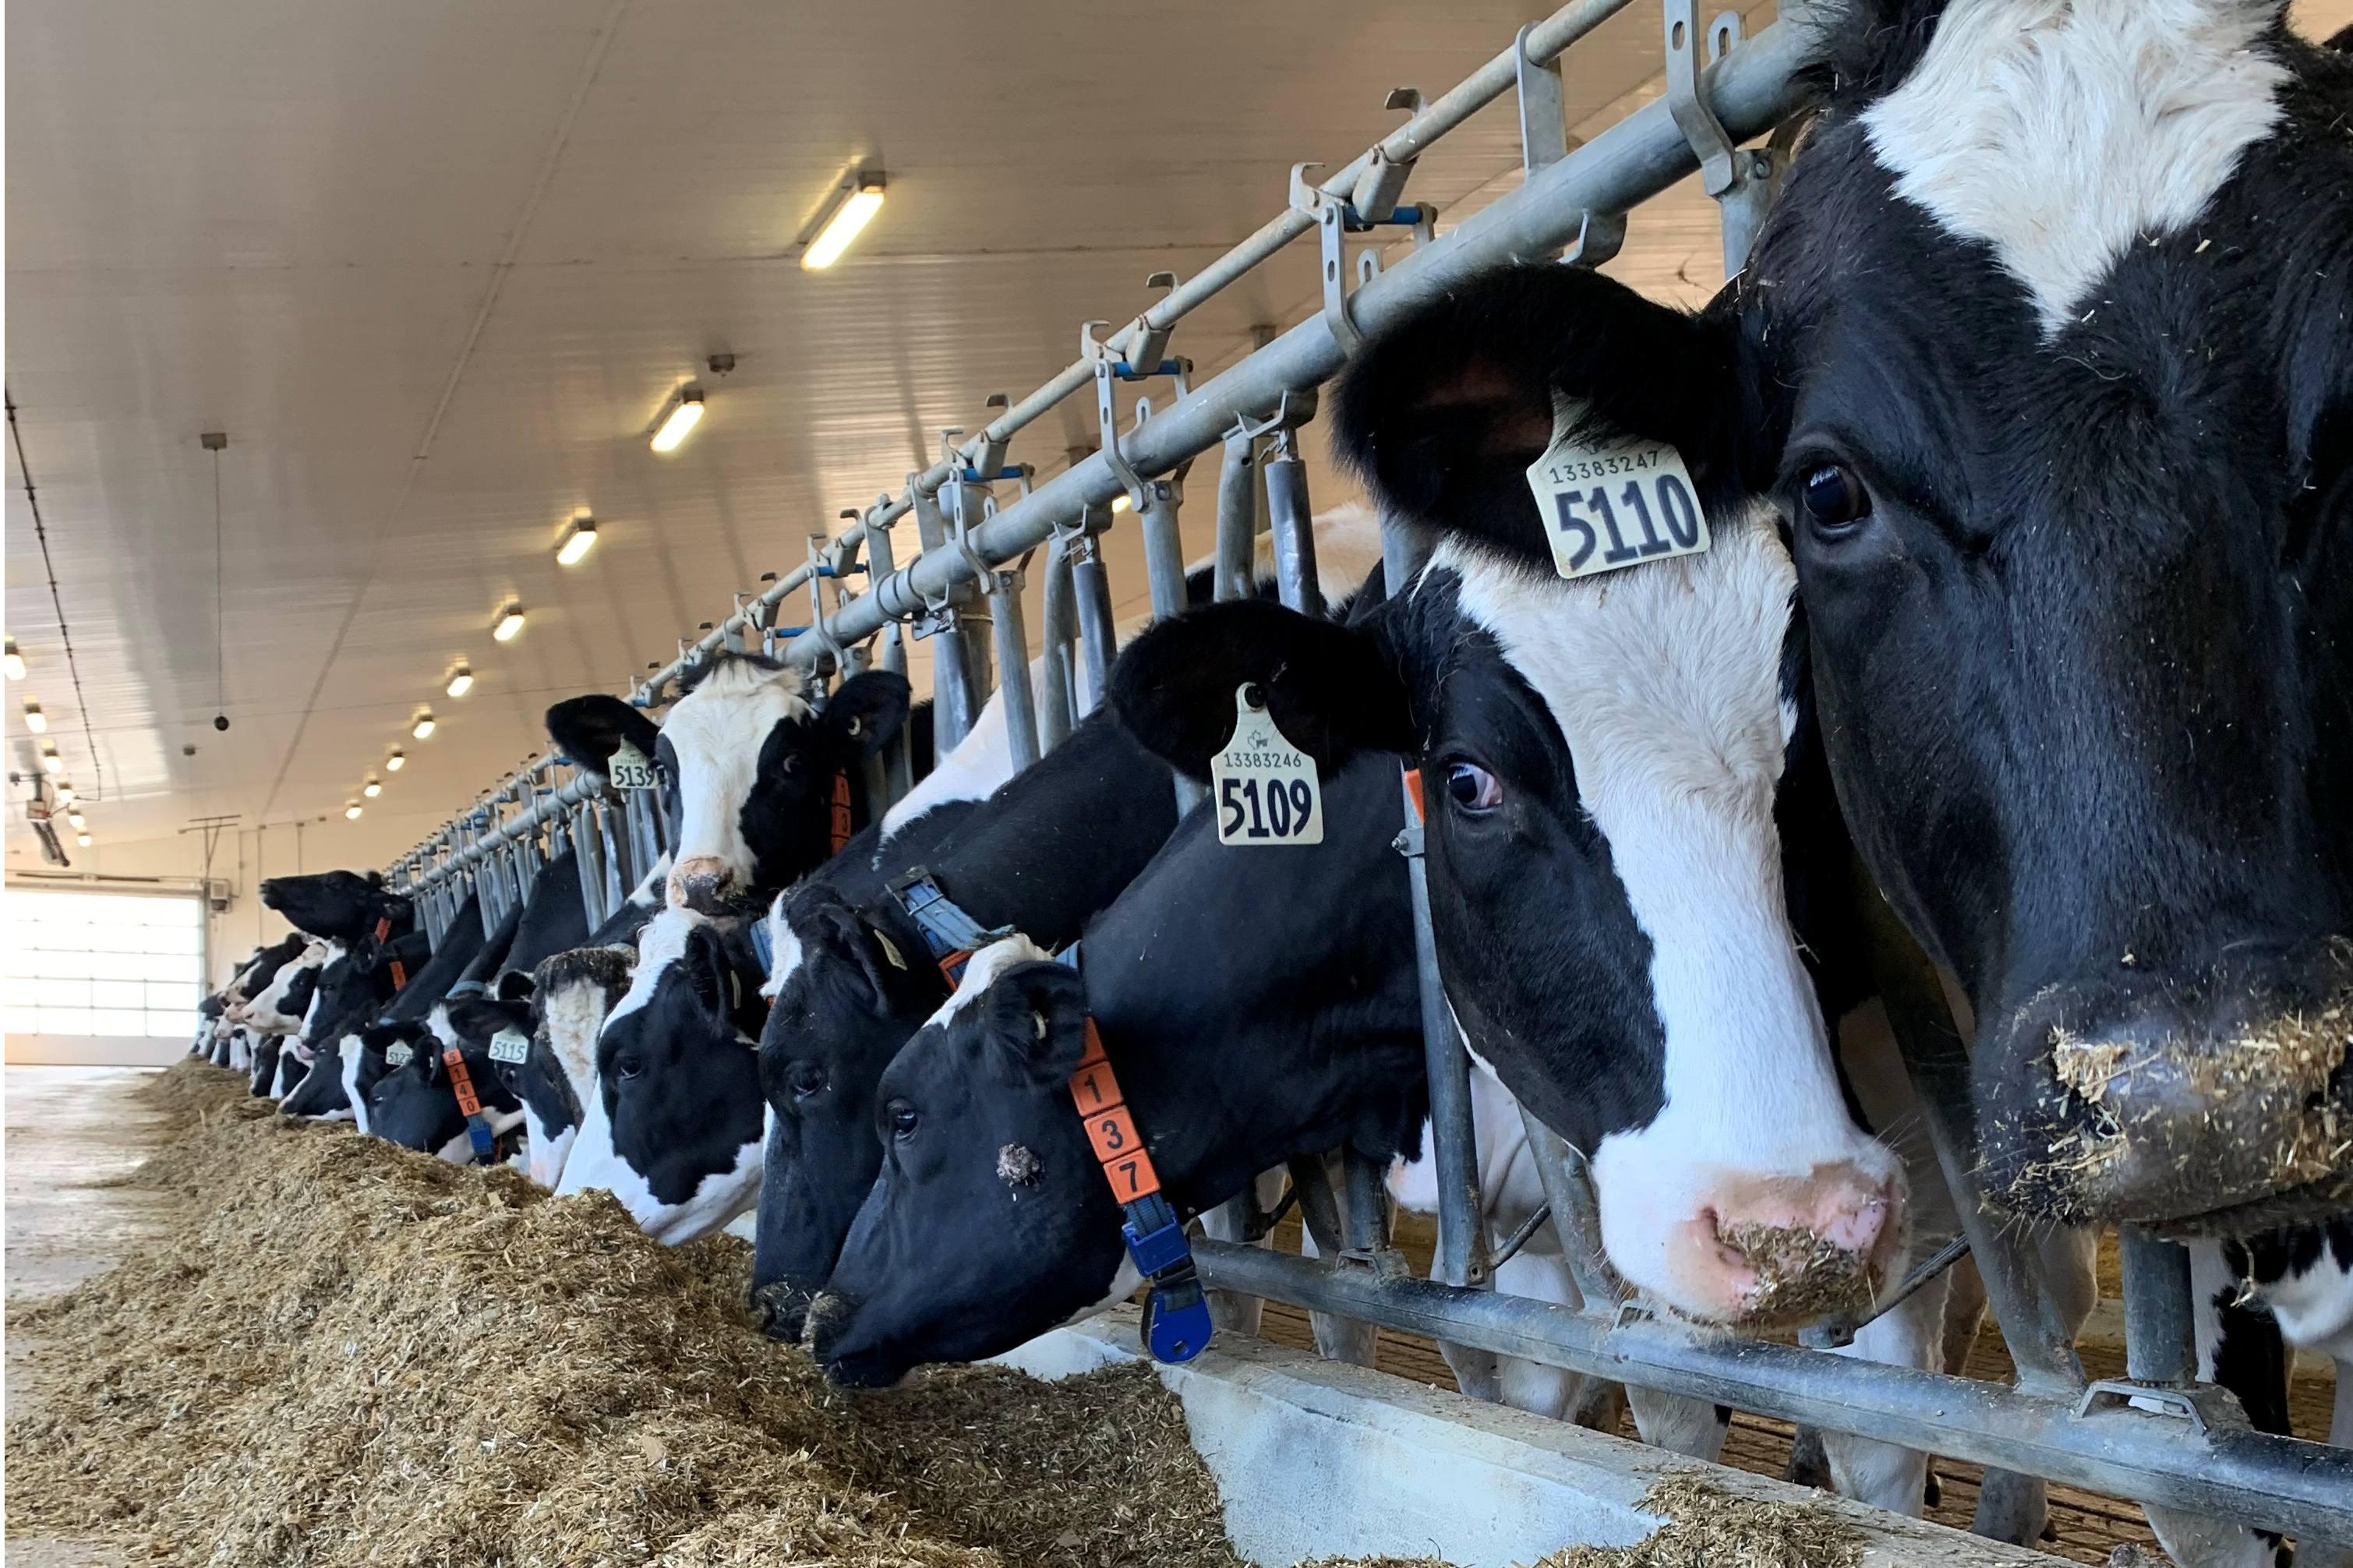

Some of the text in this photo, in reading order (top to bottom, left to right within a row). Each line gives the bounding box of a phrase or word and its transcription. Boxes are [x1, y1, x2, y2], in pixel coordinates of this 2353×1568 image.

[1549, 450, 1659, 484] 13383247
[1554, 473, 1699, 572] 5110
[1223, 752, 1302, 768] 13383246
[614, 765, 655, 787] 5139
[1221, 778, 1313, 838] 5109
[491, 1040, 526, 1061] 5115
